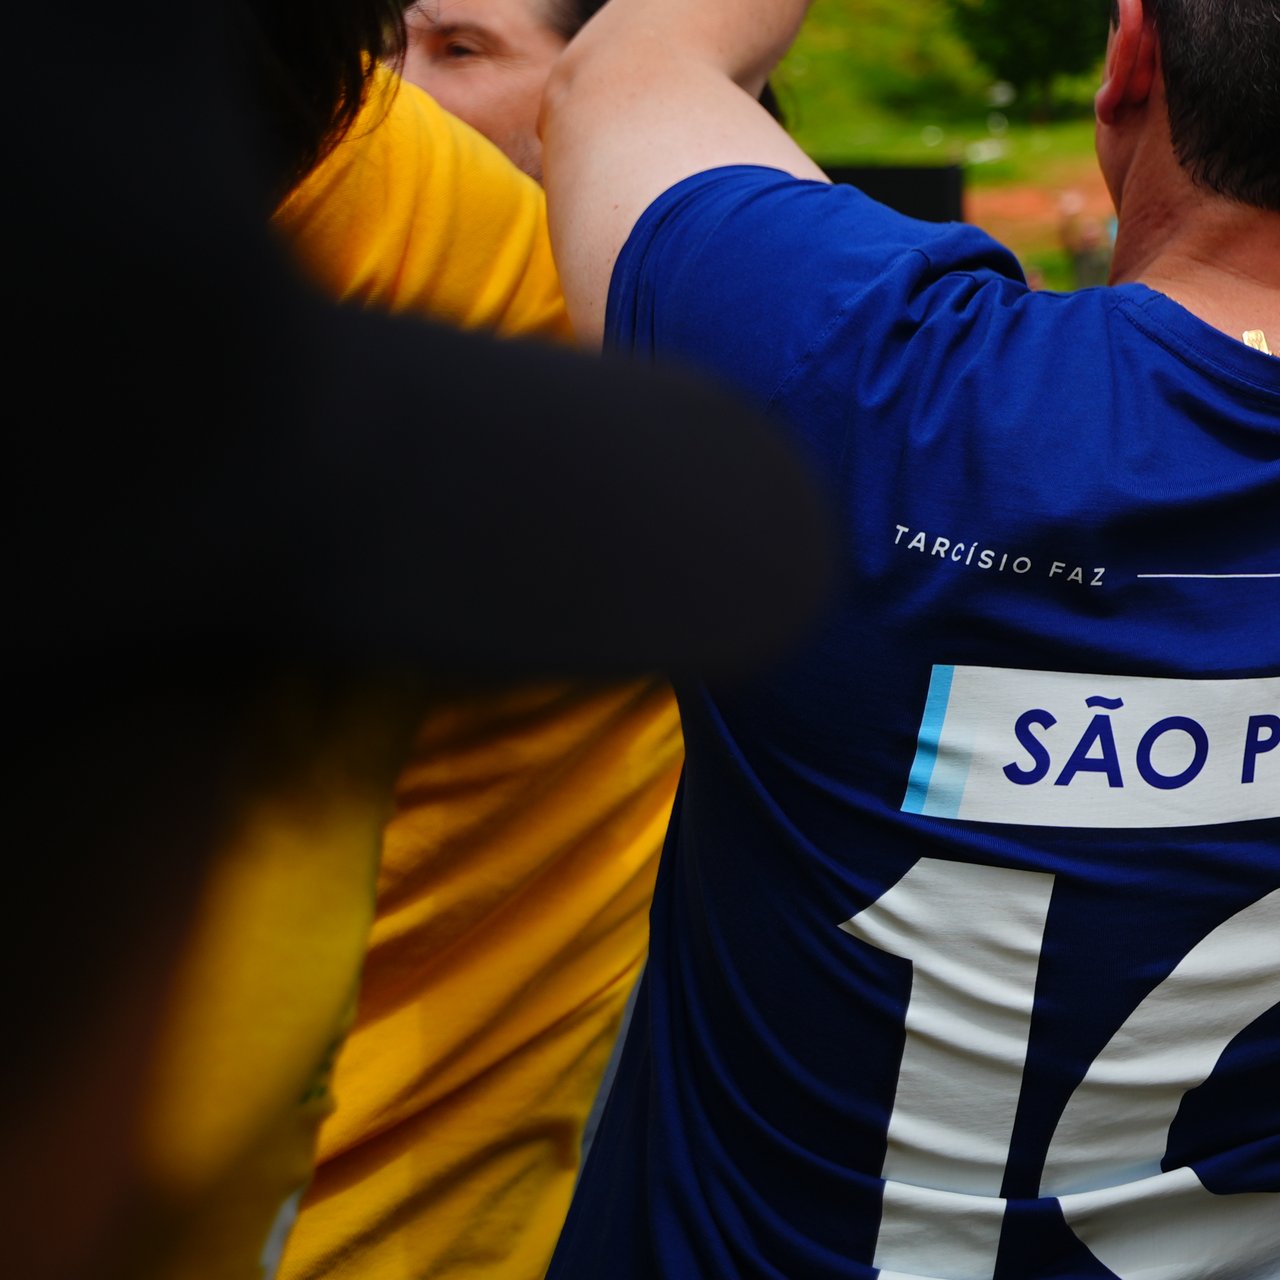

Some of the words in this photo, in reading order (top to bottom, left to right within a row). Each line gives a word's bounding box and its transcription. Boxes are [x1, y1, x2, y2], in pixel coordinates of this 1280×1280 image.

[894, 524, 1032, 574] TARCÍSIO
[1048, 561, 1106, 587] FAZ
[1002, 695, 1210, 790] SÃO
